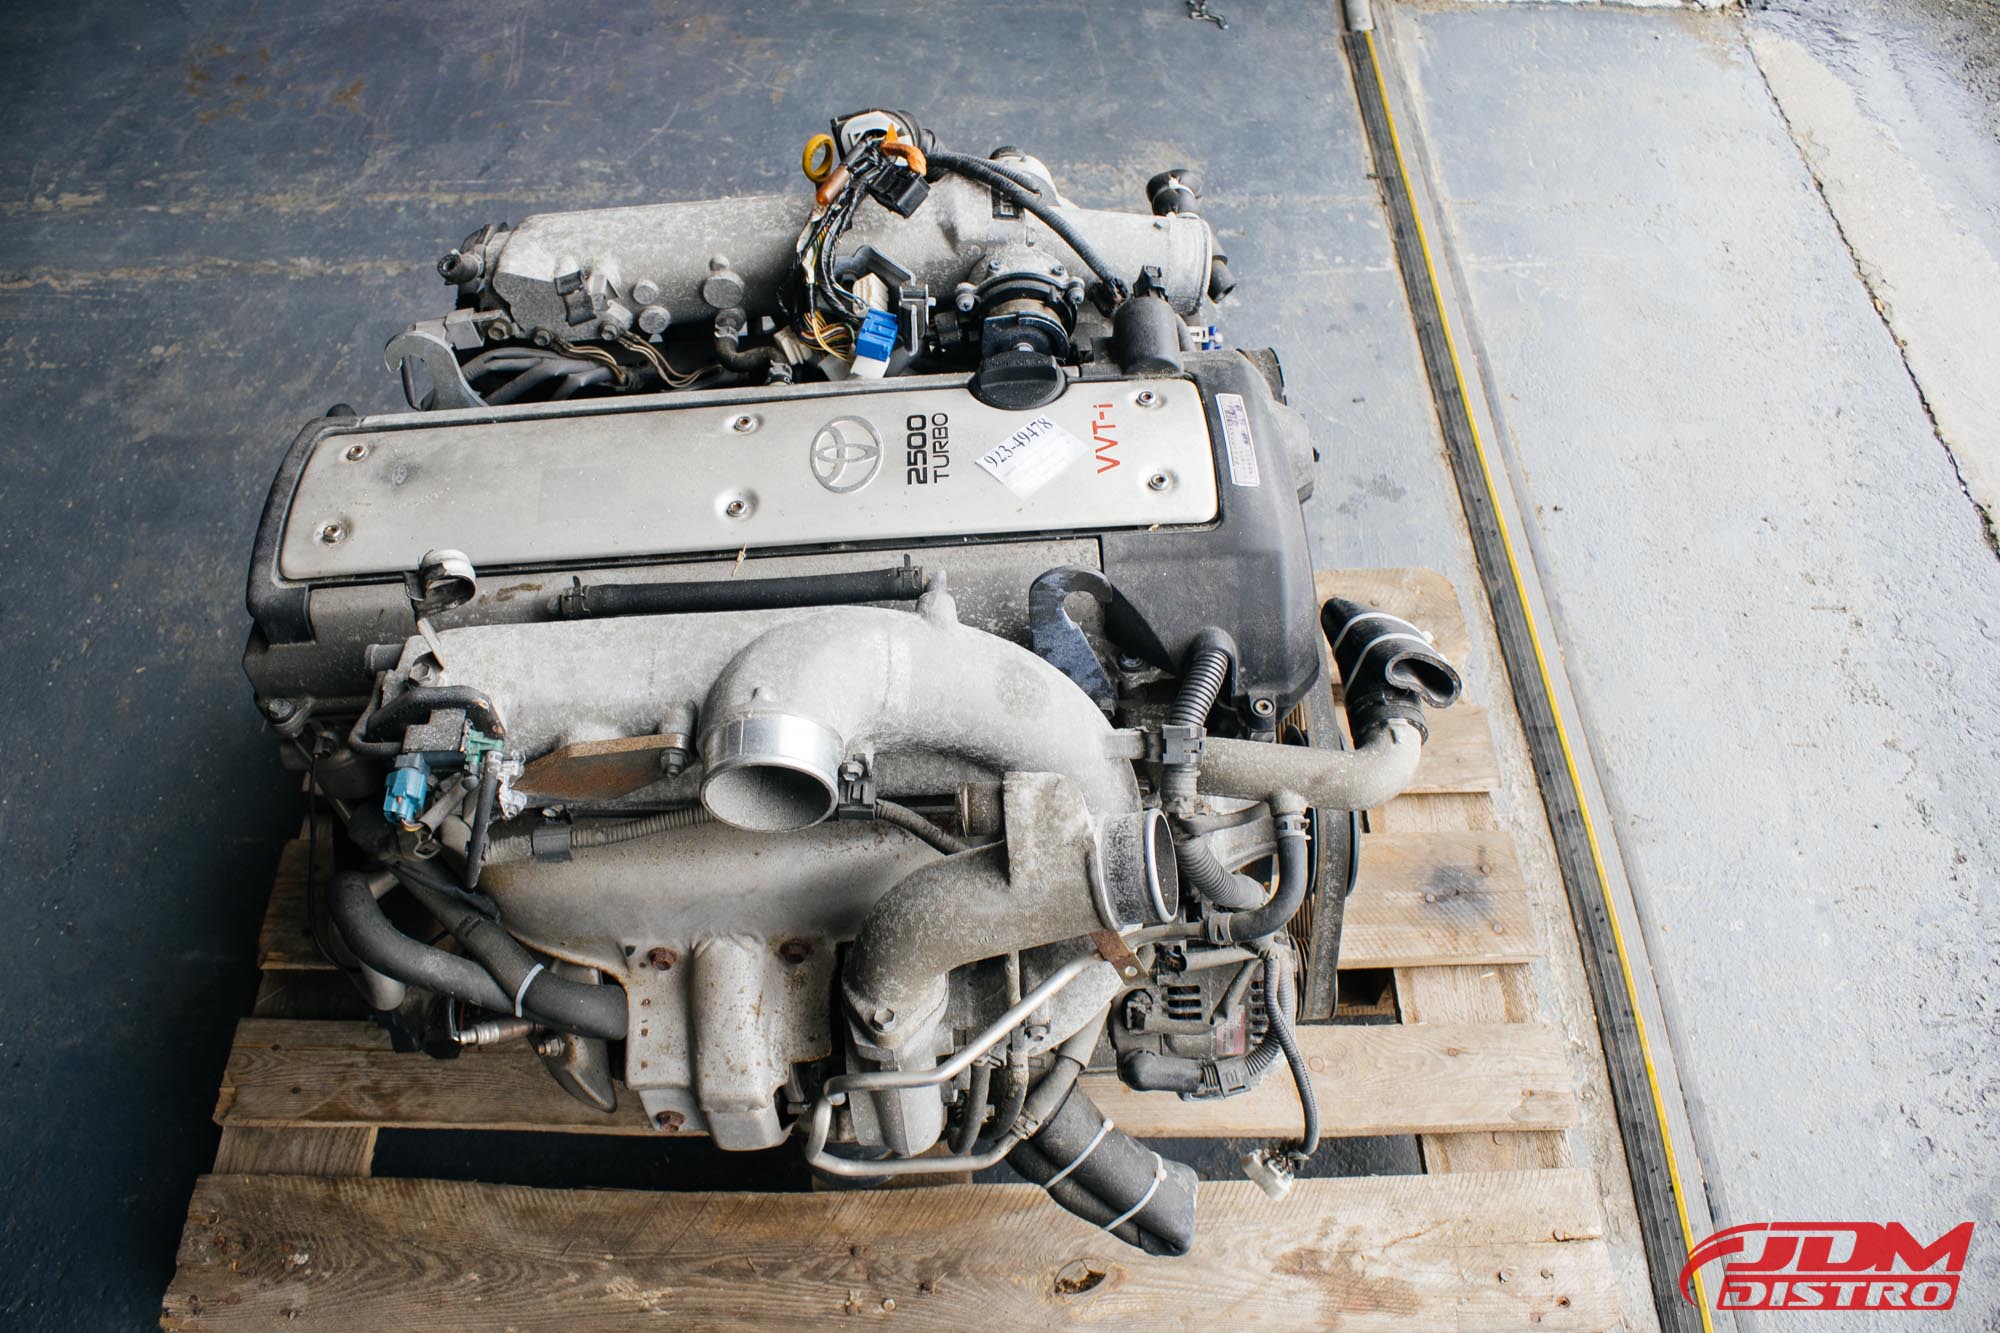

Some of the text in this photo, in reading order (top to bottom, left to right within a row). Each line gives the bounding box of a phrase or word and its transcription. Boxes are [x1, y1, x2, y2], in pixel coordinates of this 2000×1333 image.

[906, 414, 928, 485] 2500
[931, 412, 950, 484] TURBO
[983, 417, 1053, 468] 923-49478
[1092, 403, 1121, 474] VVT-i
